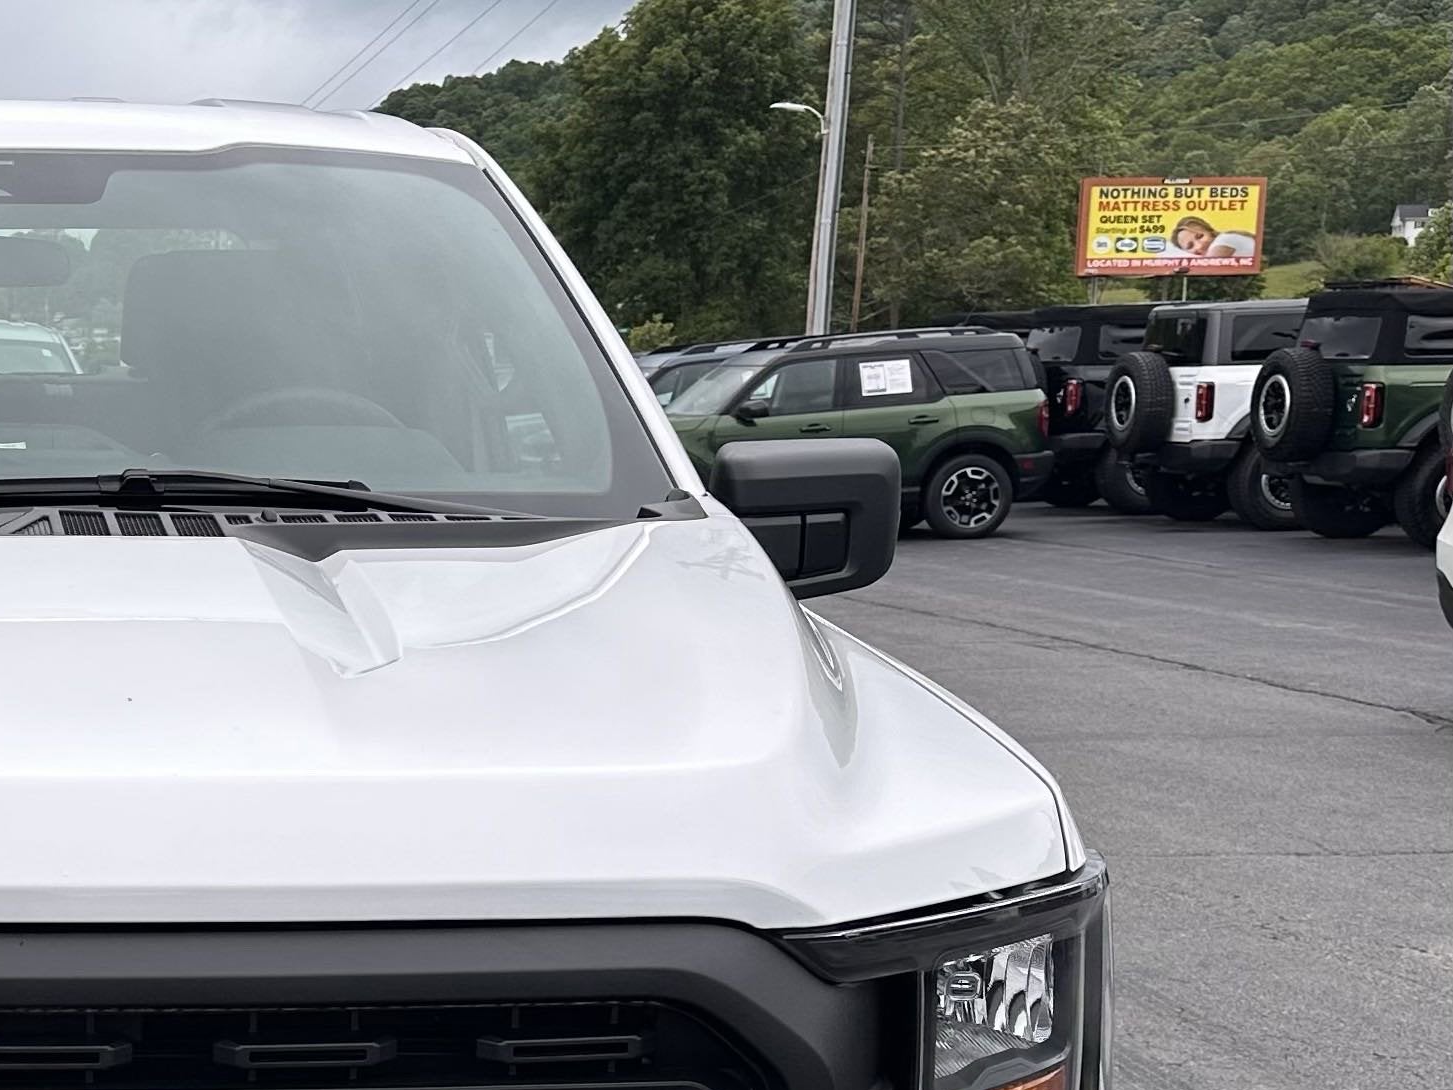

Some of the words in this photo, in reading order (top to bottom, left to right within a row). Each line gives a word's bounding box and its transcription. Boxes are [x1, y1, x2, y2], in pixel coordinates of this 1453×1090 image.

[1099, 187, 1169, 200] NOTHING
[1174, 187, 1205, 199] BUT
[1209, 186, 1249, 199] BEDS
[1098, 200, 1181, 212] MATTRESS
[1186, 200, 1248, 211] OUTLET
[1099, 215, 1139, 224] QUEEN
[1141, 214, 1163, 223] SET
[1095, 227, 1128, 235] Starting
[1139, 225, 1166, 234] $499
[1087, 259, 1130, 268] LOCATED
[1130, 259, 1141, 267] IN
[1142, 258, 1181, 267] MURPHY
[1239, 257, 1253, 266] NC
